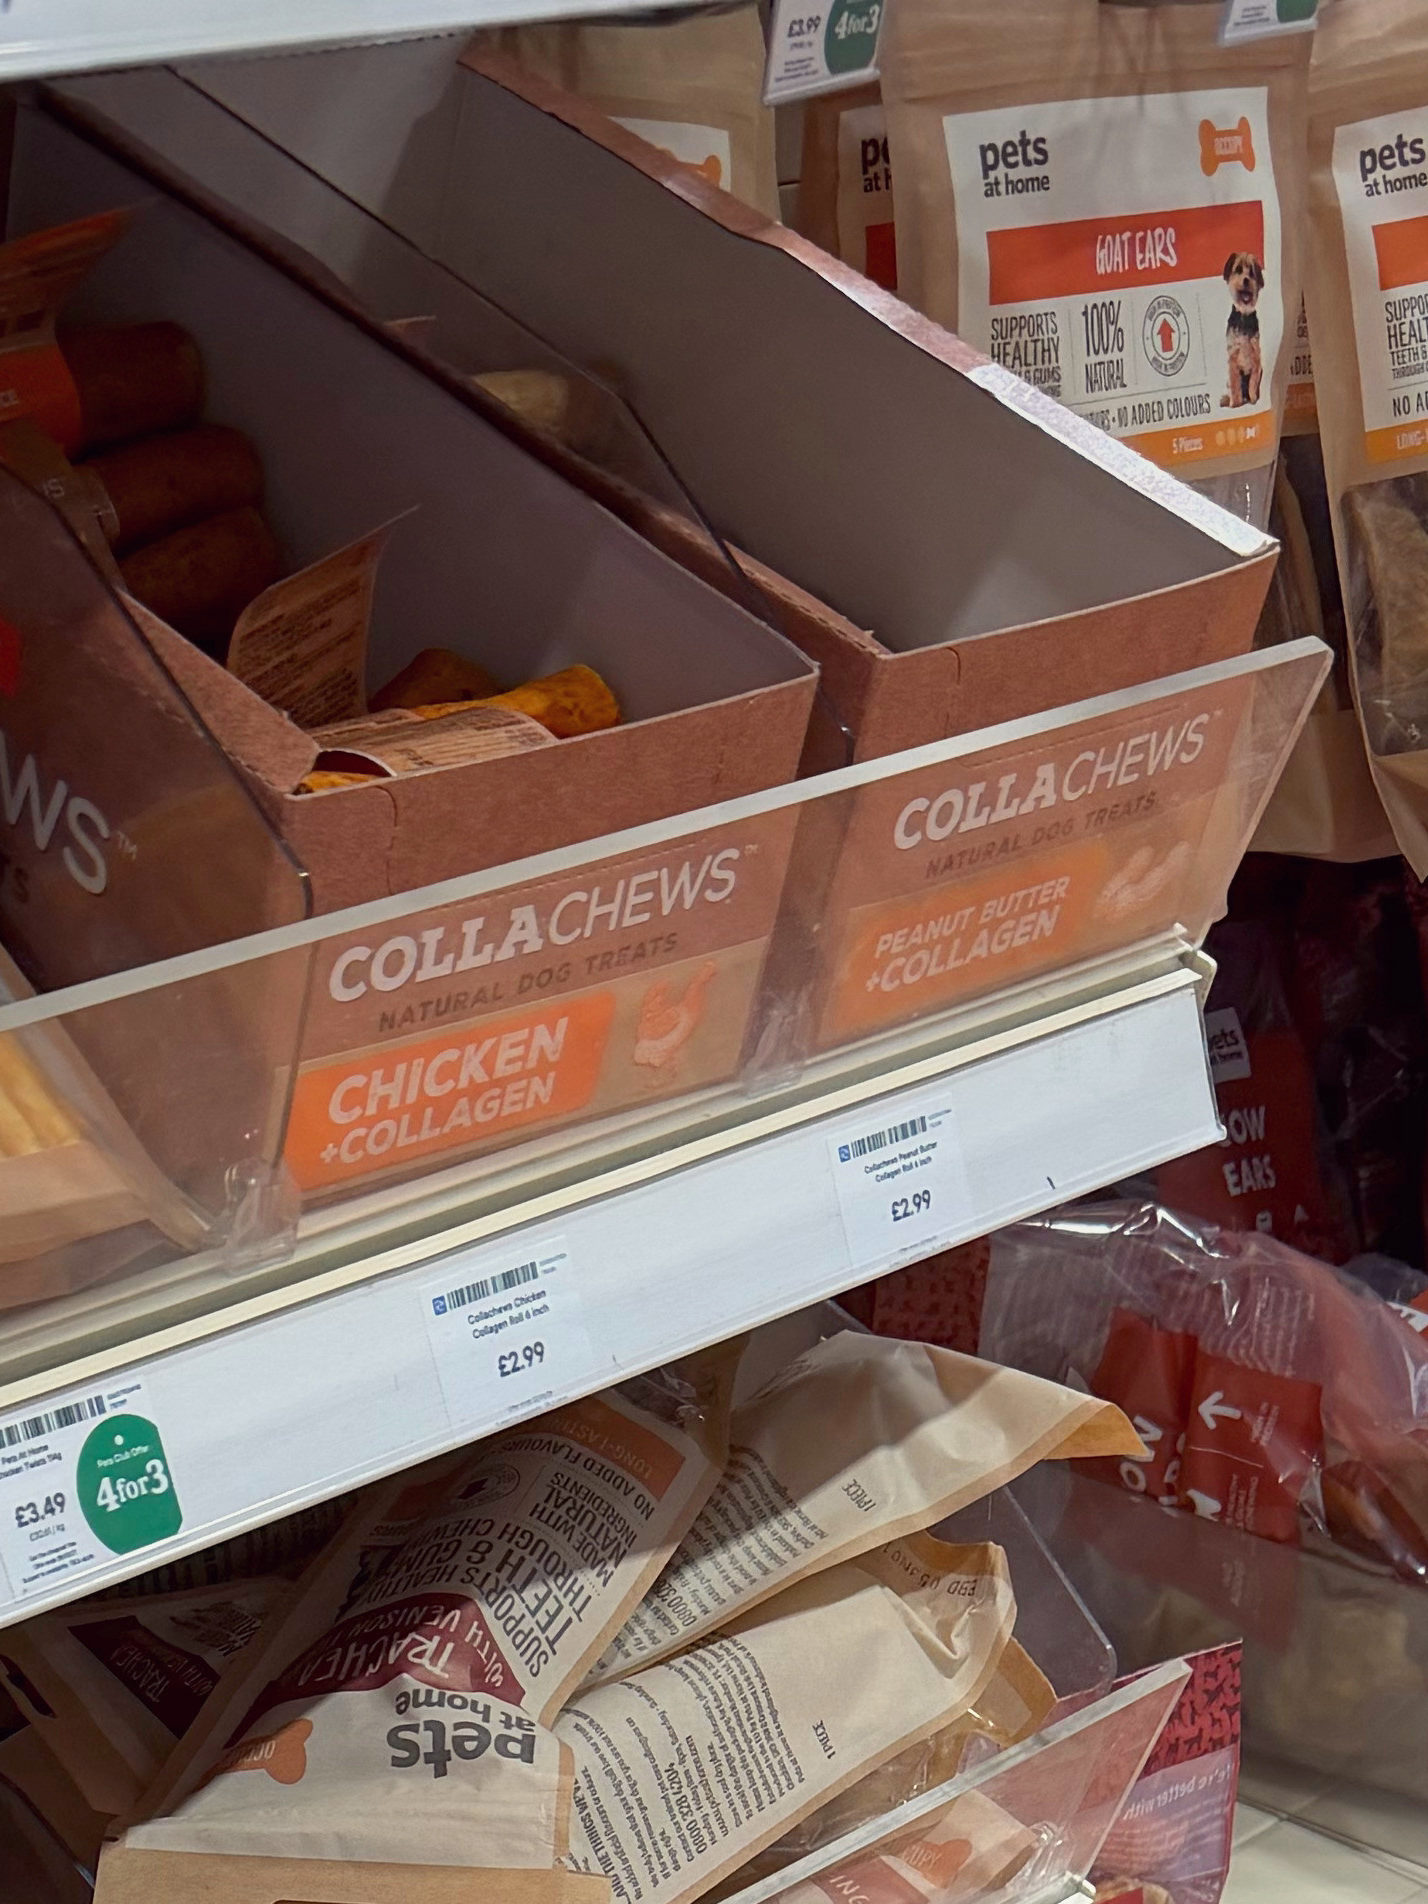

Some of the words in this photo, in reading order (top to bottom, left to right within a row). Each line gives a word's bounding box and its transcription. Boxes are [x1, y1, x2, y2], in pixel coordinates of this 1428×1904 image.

[979, 130, 1049, 180] pets
[1359, 134, 1426, 181] pets
[983, 172, 1003, 199] at
[1004, 172, 1051, 195] home
[1364, 178, 1382, 197] at
[1383, 169, 1428, 195] home
[1095, 231, 1132, 276] GOAT
[1135, 227, 1177, 270] EARS
[991, 312, 1058, 341] SUPPORTS
[1082, 300, 1125, 357] 100%
[990, 335, 1060, 368] HEALTHY
[1389, 346, 1420, 367] TEETH
[1131, 397, 1165, 426] ADDED
[1167, 393, 1211, 420] COLOURS
[1392, 397, 1411, 419] NO
[893, 713, 1209, 851] COLLACHEWS
[924, 833, 1024, 880] NATURAL
[1030, 815, 1074, 846] DOG
[1083, 789, 1158, 831] TREATS
[328, 847, 741, 1002] COLLACHEWS
[874, 908, 973, 960] PEANUT
[980, 875, 1070, 924] BUTTER
[378, 982, 505, 1032] NATURAL
[518, 962, 571, 990] DOG
[585, 932, 678, 976] TREATS
[327, 1017, 568, 1124] CHICKEN
[891, 1189, 931, 1222] £2.99
[513, 1289, 547, 1308] Chicken
[472, 1319, 508, 1340] Collagen
[509, 1313, 524, 1326] Roll
[532, 1304, 550, 1318] inch
[498, 1341, 545, 1378] £2.99
[96, 1459, 169, 1512] 4for3
[15, 1492, 66, 1528] £3.49
[395, 1684, 497, 1722] home
[502, 1707, 536, 1732] at
[386, 1719, 537, 1778] pets
